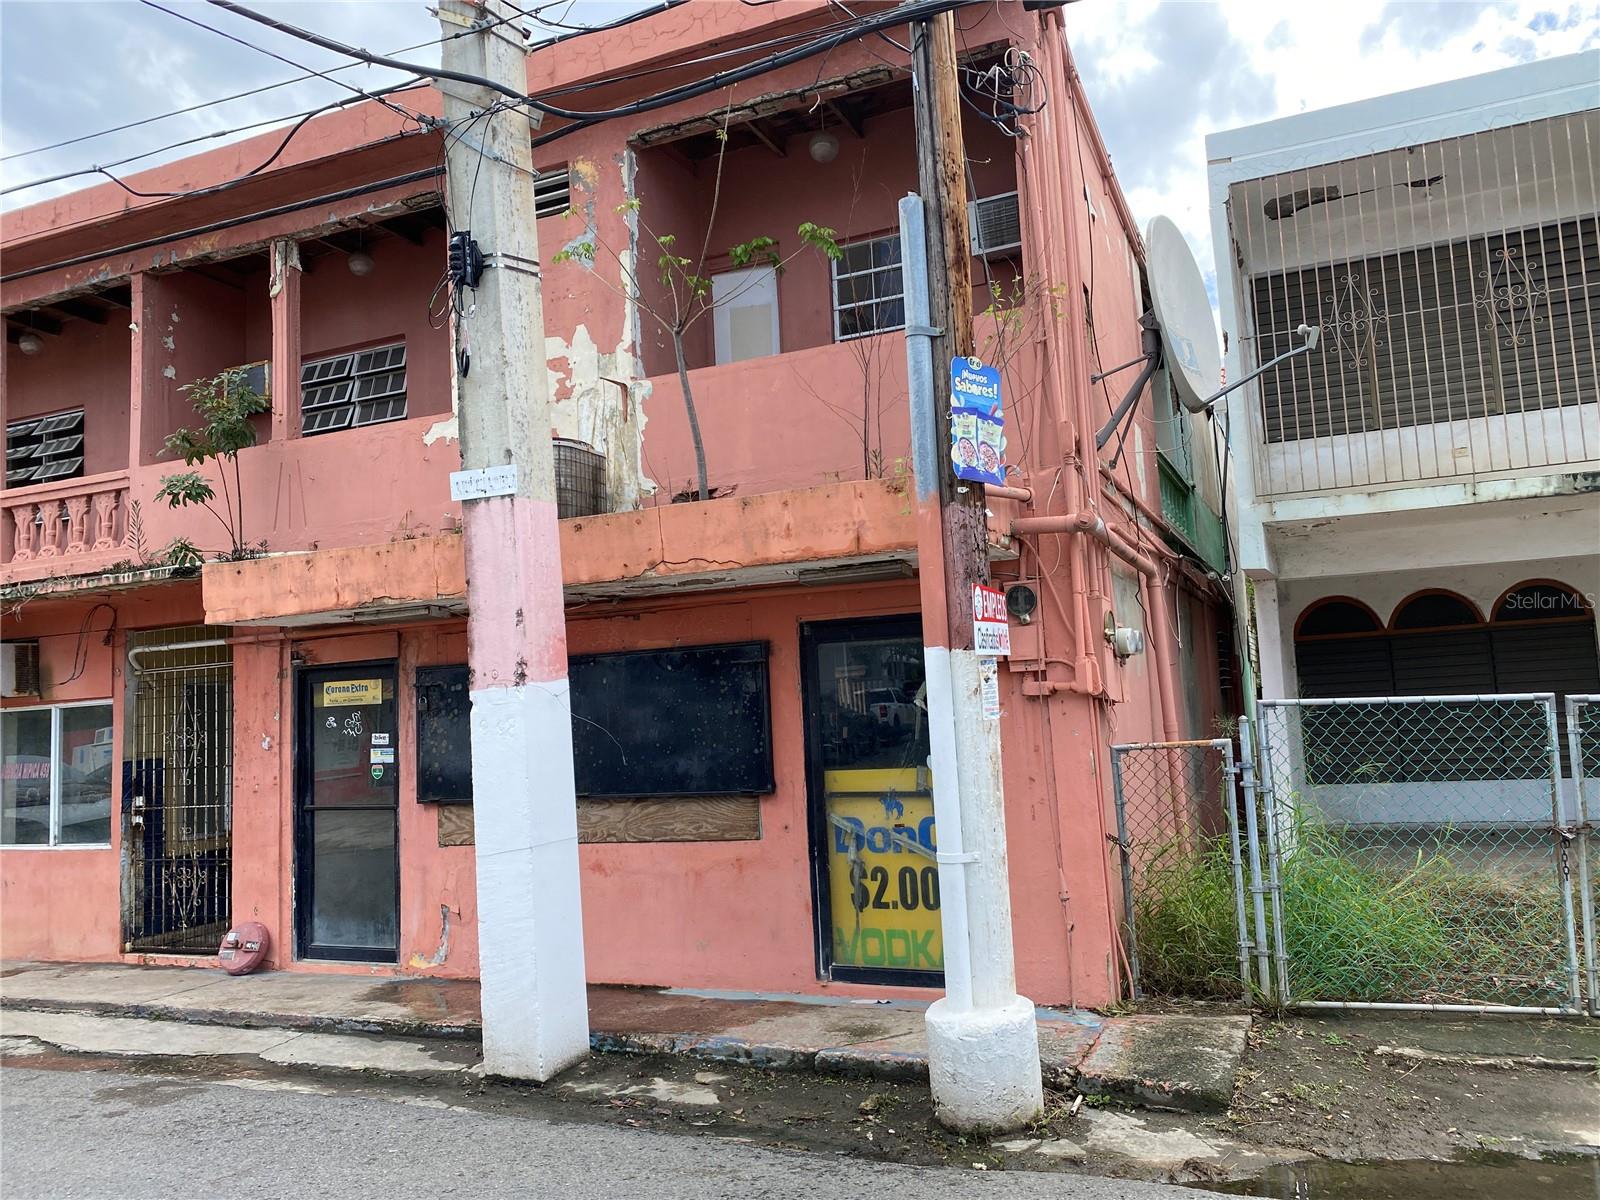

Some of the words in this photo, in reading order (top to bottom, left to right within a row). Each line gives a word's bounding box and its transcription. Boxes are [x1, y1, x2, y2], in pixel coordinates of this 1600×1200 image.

[954, 377, 998, 399] Sabores!
[983, 590, 1008, 621] EMPLEOS
[326, 685, 350, 695] Corona
[351, 684, 368, 693] Extra
[849, 866, 941, 912] $2.00
